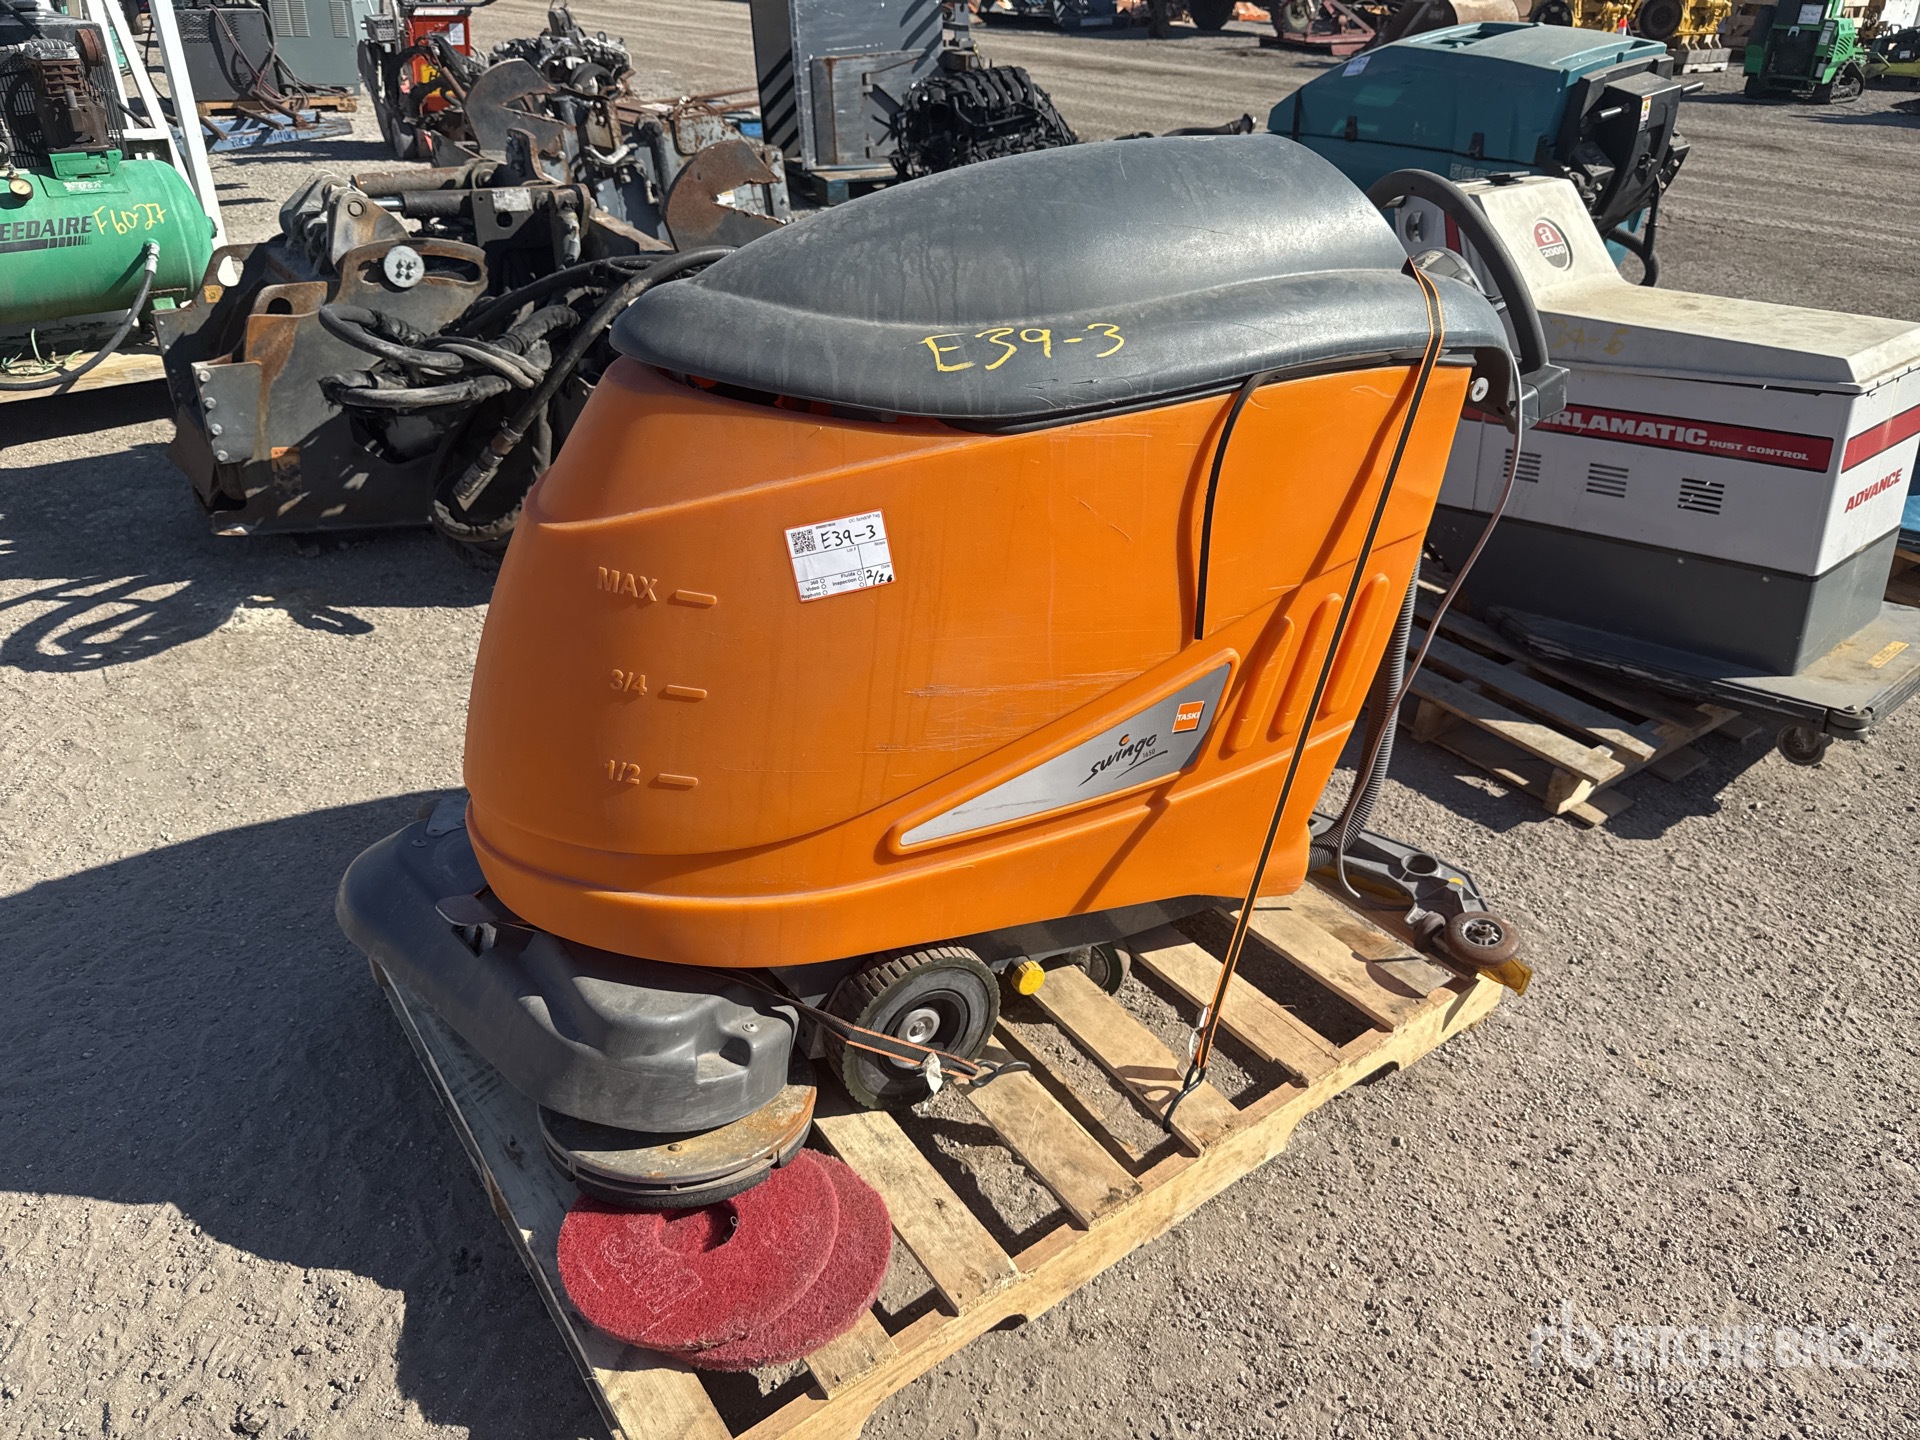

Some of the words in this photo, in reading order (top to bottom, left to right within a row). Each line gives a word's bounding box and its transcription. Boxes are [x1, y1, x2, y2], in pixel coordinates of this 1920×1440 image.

[1542, 245, 1566, 258] 2000
[919, 323, 1125, 372] E39-3
[1709, 439, 1743, 451] DUST
[1747, 445, 1809, 461] CONTROL
[1845, 468, 1903, 514] ADVANCE
[821, 524, 876, 549] E39-3
[598, 566, 658, 602] MAX
[832, 577, 858, 587] Inspection
[609, 668, 648, 696] 3/4
[1176, 710, 1200, 722] TASKI
[1142, 748, 1156, 759] 1650
[604, 759, 642, 785] 1/2
